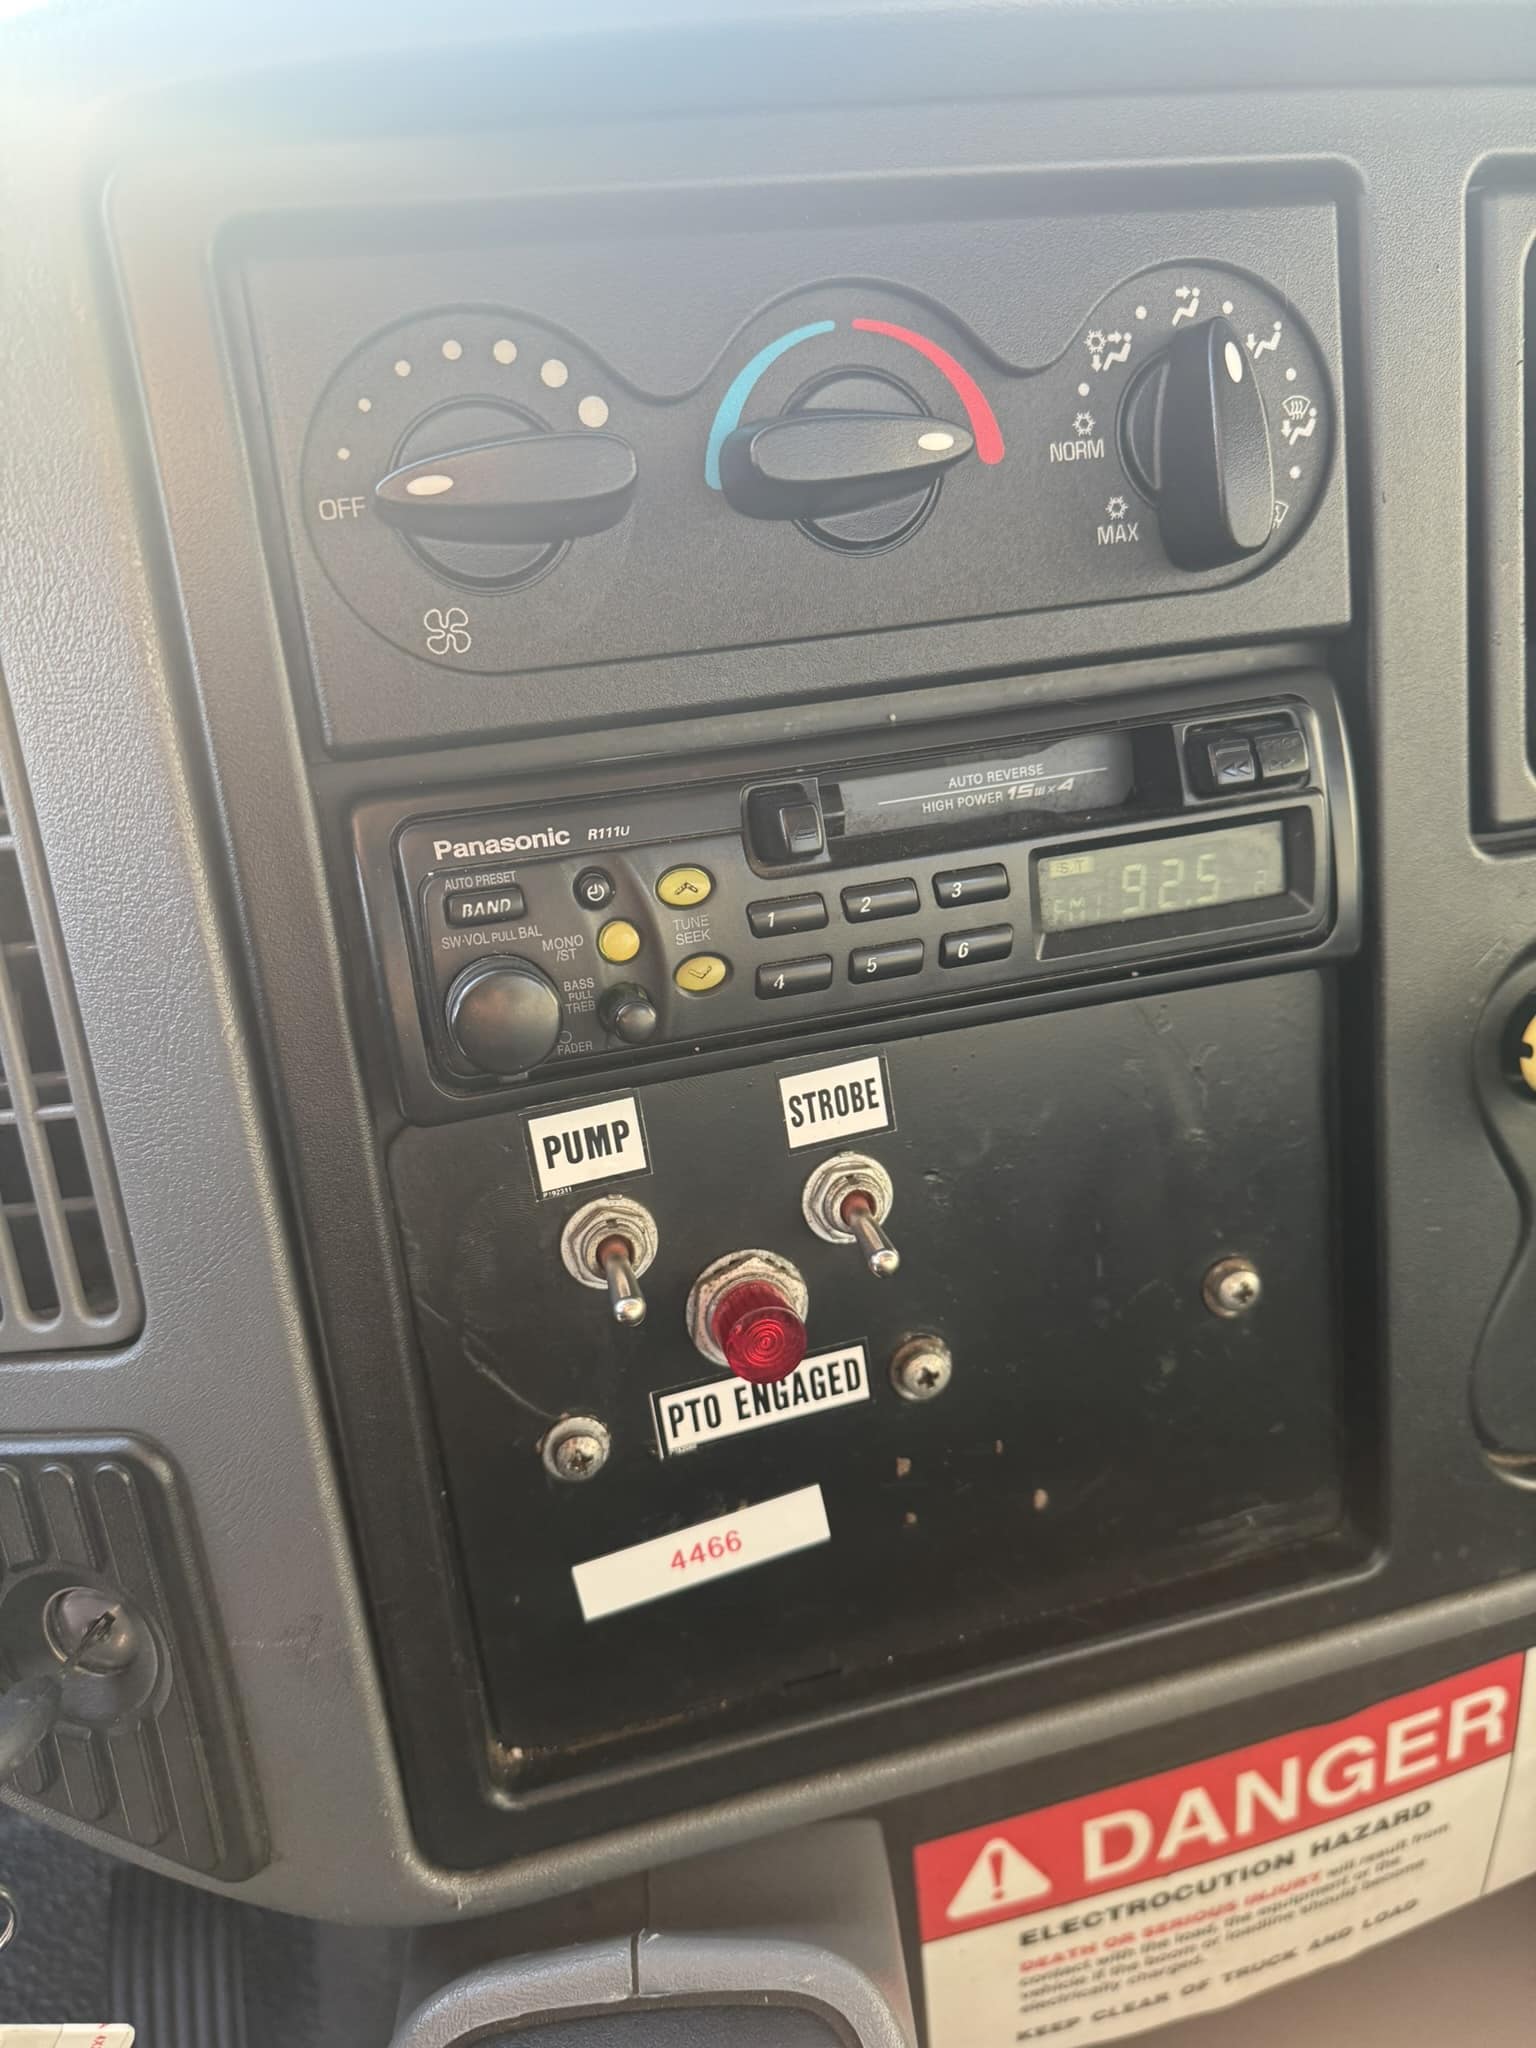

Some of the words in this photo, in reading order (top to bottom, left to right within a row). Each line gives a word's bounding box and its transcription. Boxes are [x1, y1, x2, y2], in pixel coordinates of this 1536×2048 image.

[1050, 439, 1105, 463] NORM
[318, 496, 366, 520] OFF
[1097, 522, 1139, 545] MAX
[949, 773, 983, 789] AUTO
[987, 764, 1045, 782] REVERSE
[922, 799, 954, 813] HIGH
[958, 791, 1004, 808] POWER
[588, 825, 630, 841] R111U
[433, 827, 570, 861] Panasonic
[444, 877, 474, 891] AUTO
[475, 871, 517, 886] PRESET
[951, 882, 962, 898] 3
[462, 898, 512, 918] BAND
[861, 896, 871, 913] 2
[672, 915, 710, 931] TUNE
[767, 912, 775, 928] 1
[491, 930, 517, 943] PULL
[519, 925, 543, 939] BAL
[542, 935, 584, 951] MONO
[675, 929, 711, 946] SEEK
[958, 942, 969, 958] 6
[866, 958, 877, 973] 5
[563, 978, 595, 992] BASS
[774, 974, 785, 990] 4
[568, 988, 593, 1001] PULL
[565, 1000, 596, 1014] TREB
[557, 1041, 593, 1056] FADER
[788, 1077, 880, 1128] STROBE
[542, 1119, 630, 1170] PUMP
[667, 1394, 722, 1438] PTO
[734, 1358, 861, 1420] ENGAGED
[670, 1529, 743, 1570] 4466
[1083, 1684, 1510, 1884] DANGER
[1020, 1851, 1295, 1946] ELECTROCUTION
[1310, 1800, 1433, 1857] HAZARD
[1020, 1943, 1097, 1973] DEATH
[1103, 1932, 1136, 1949] OR
[1016, 2016, 1081, 2042] KEEP
[1091, 1992, 1170, 2022] CLEAR
[1180, 1977, 1211, 1997] OF
[1221, 1948, 1298, 1984] TRUCK
[1307, 1925, 1354, 1951] AND
[1362, 1899, 1419, 1929] LOAD
